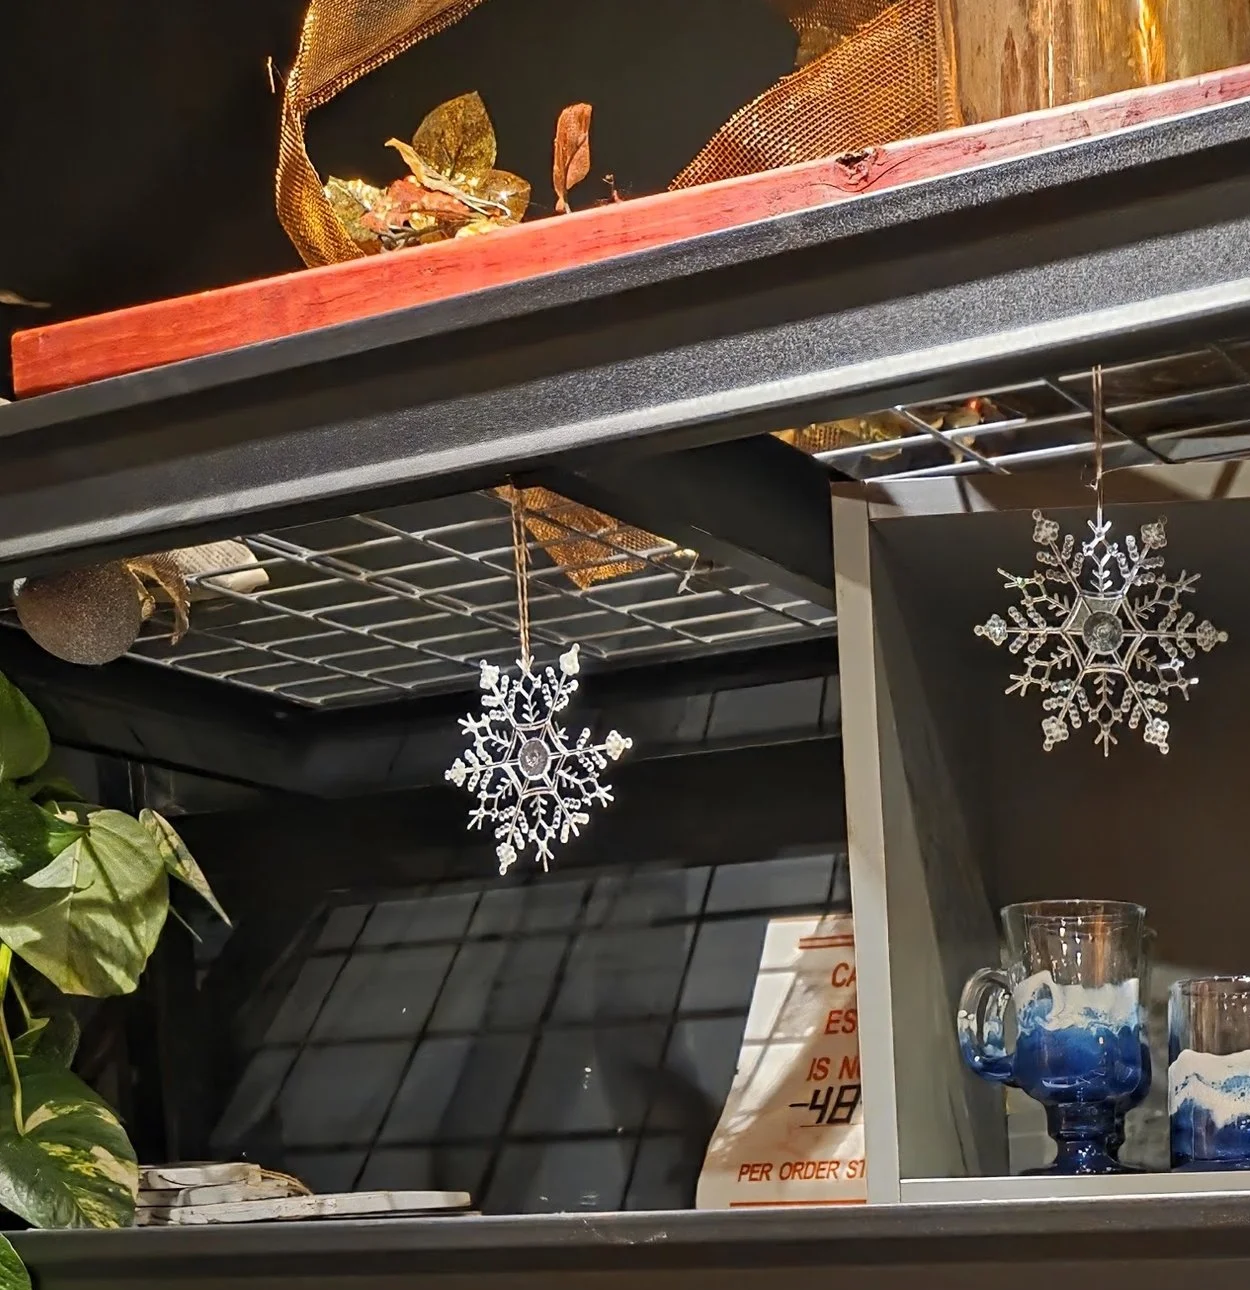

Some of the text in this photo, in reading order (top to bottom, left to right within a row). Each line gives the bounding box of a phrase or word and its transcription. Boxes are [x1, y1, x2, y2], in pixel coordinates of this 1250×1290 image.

[806, 1057, 830, 1081] IS
[738, 1163, 772, 1182] PER
[779, 1161, 839, 1182] ORDER
